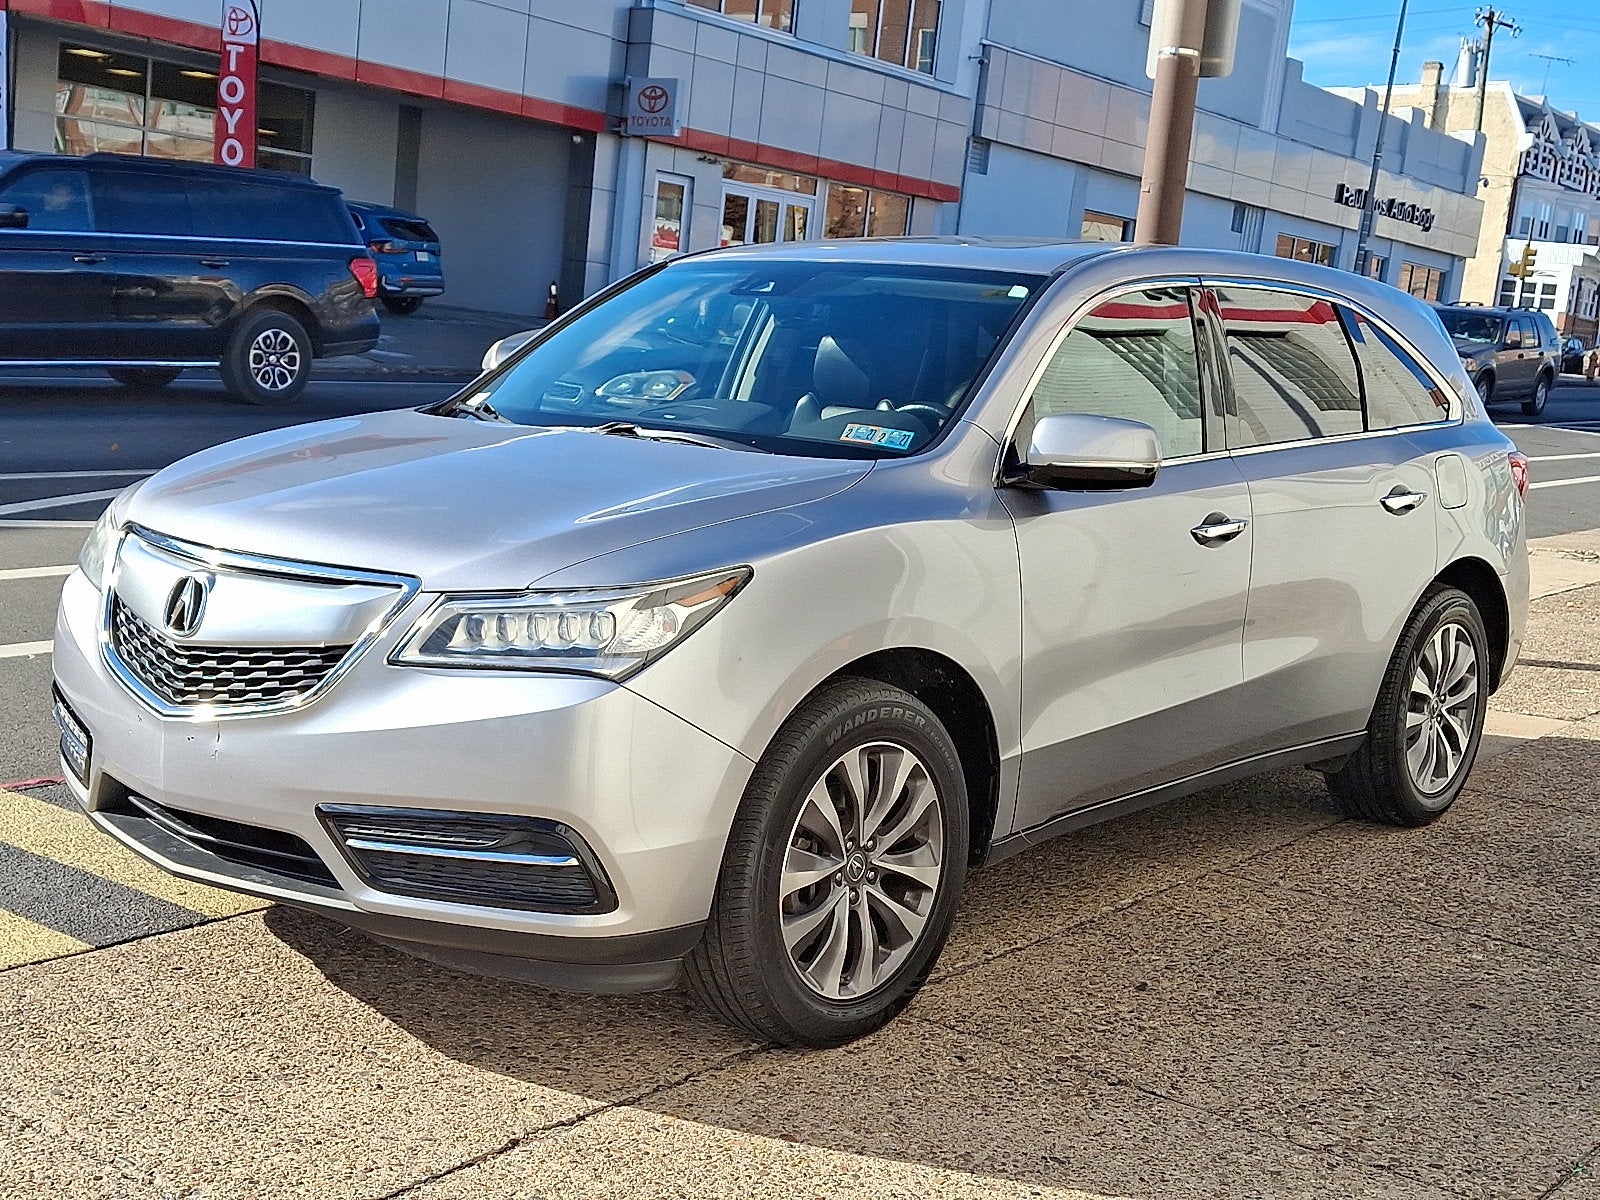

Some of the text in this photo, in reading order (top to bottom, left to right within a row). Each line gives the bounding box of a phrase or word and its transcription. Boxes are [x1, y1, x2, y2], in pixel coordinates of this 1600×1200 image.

[630, 115, 672, 127] TOYOTA
[1337, 183, 1368, 210] Paul
[1389, 198, 1413, 223] Auto
[1412, 204, 1436, 232] Body
[826, 707, 927, 747] WANDERER
